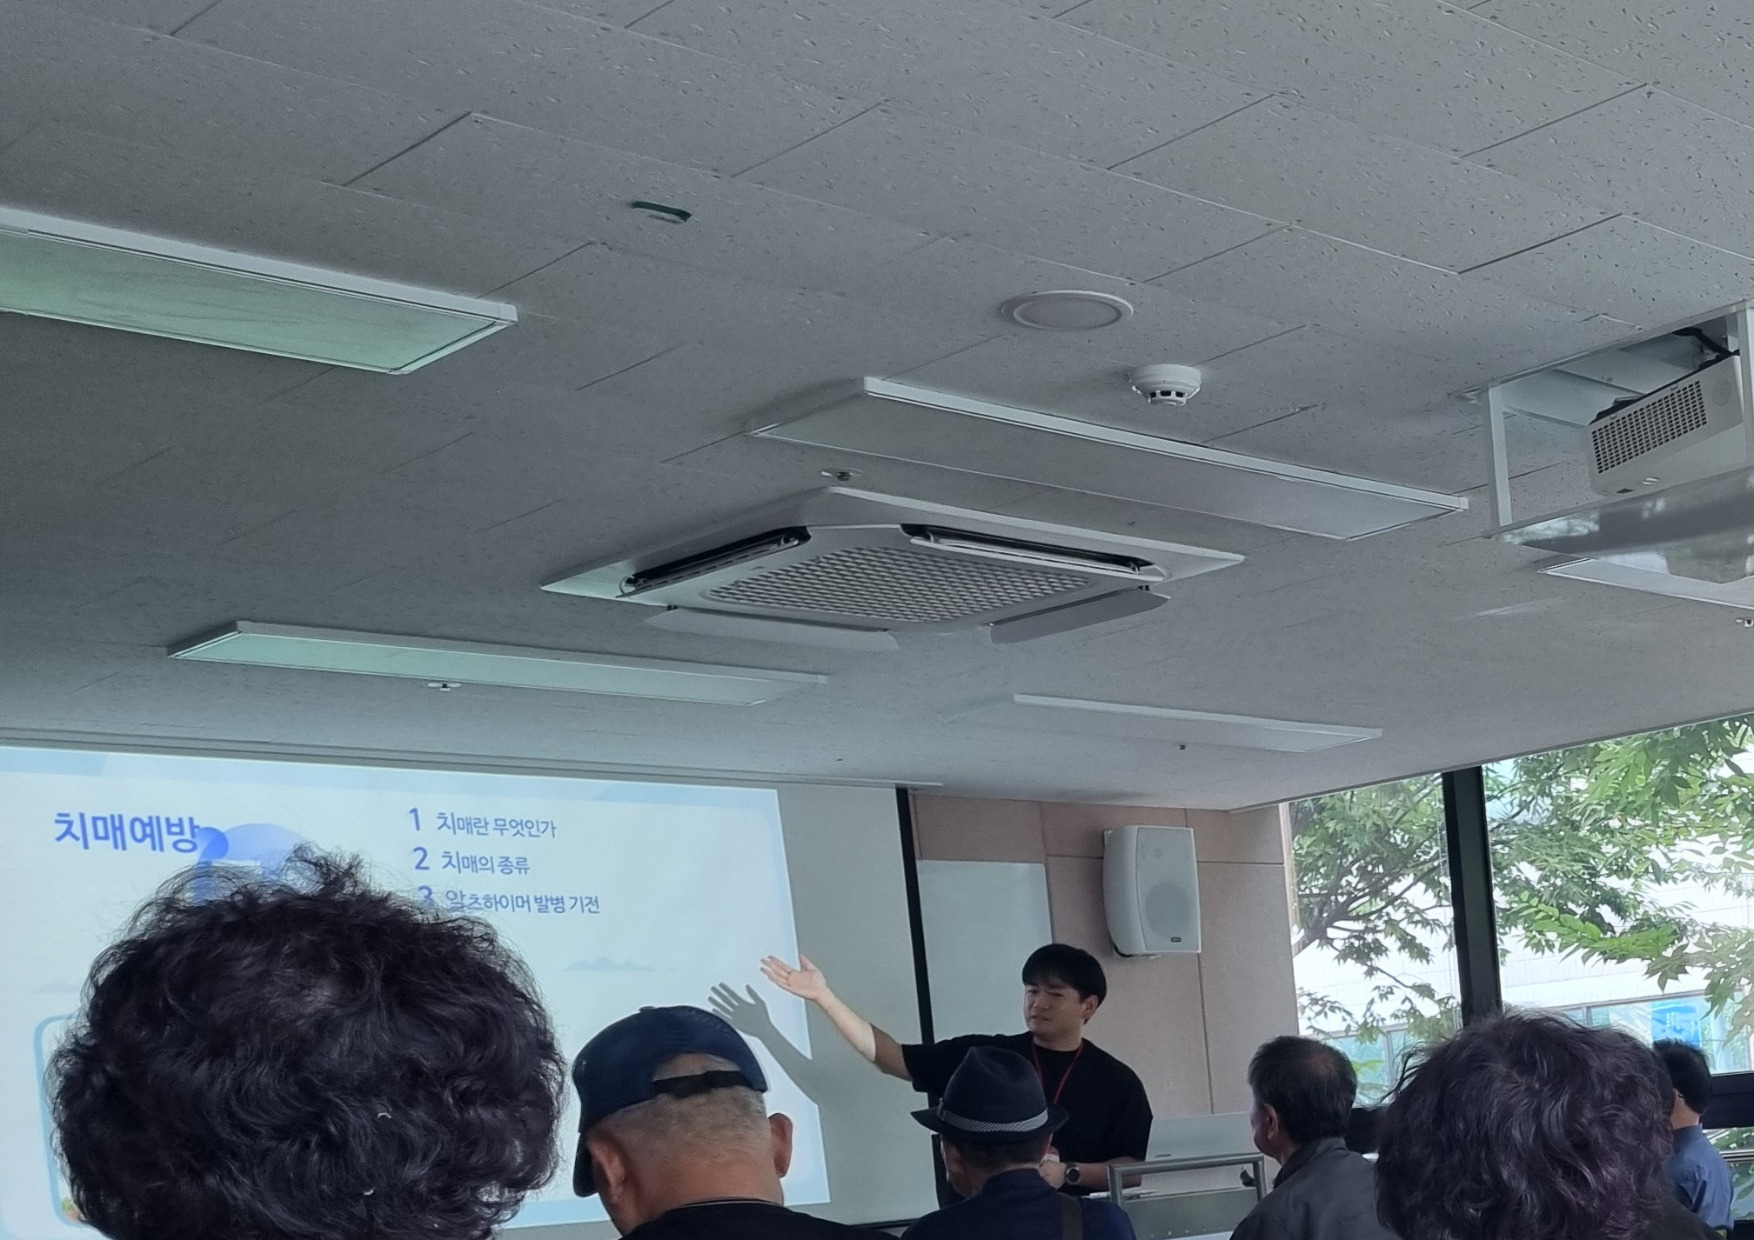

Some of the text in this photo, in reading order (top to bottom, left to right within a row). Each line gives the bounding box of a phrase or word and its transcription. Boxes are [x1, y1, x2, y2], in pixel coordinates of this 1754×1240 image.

[53, 811, 201, 854] 치매예방
[408, 807, 558, 839] 1 치매란 무엇인가
[412, 845, 531, 876] 2 치매의 종류
[417, 885, 434, 909] 3
[533, 894, 567, 914] 발병
[568, 895, 601, 915] 기전
